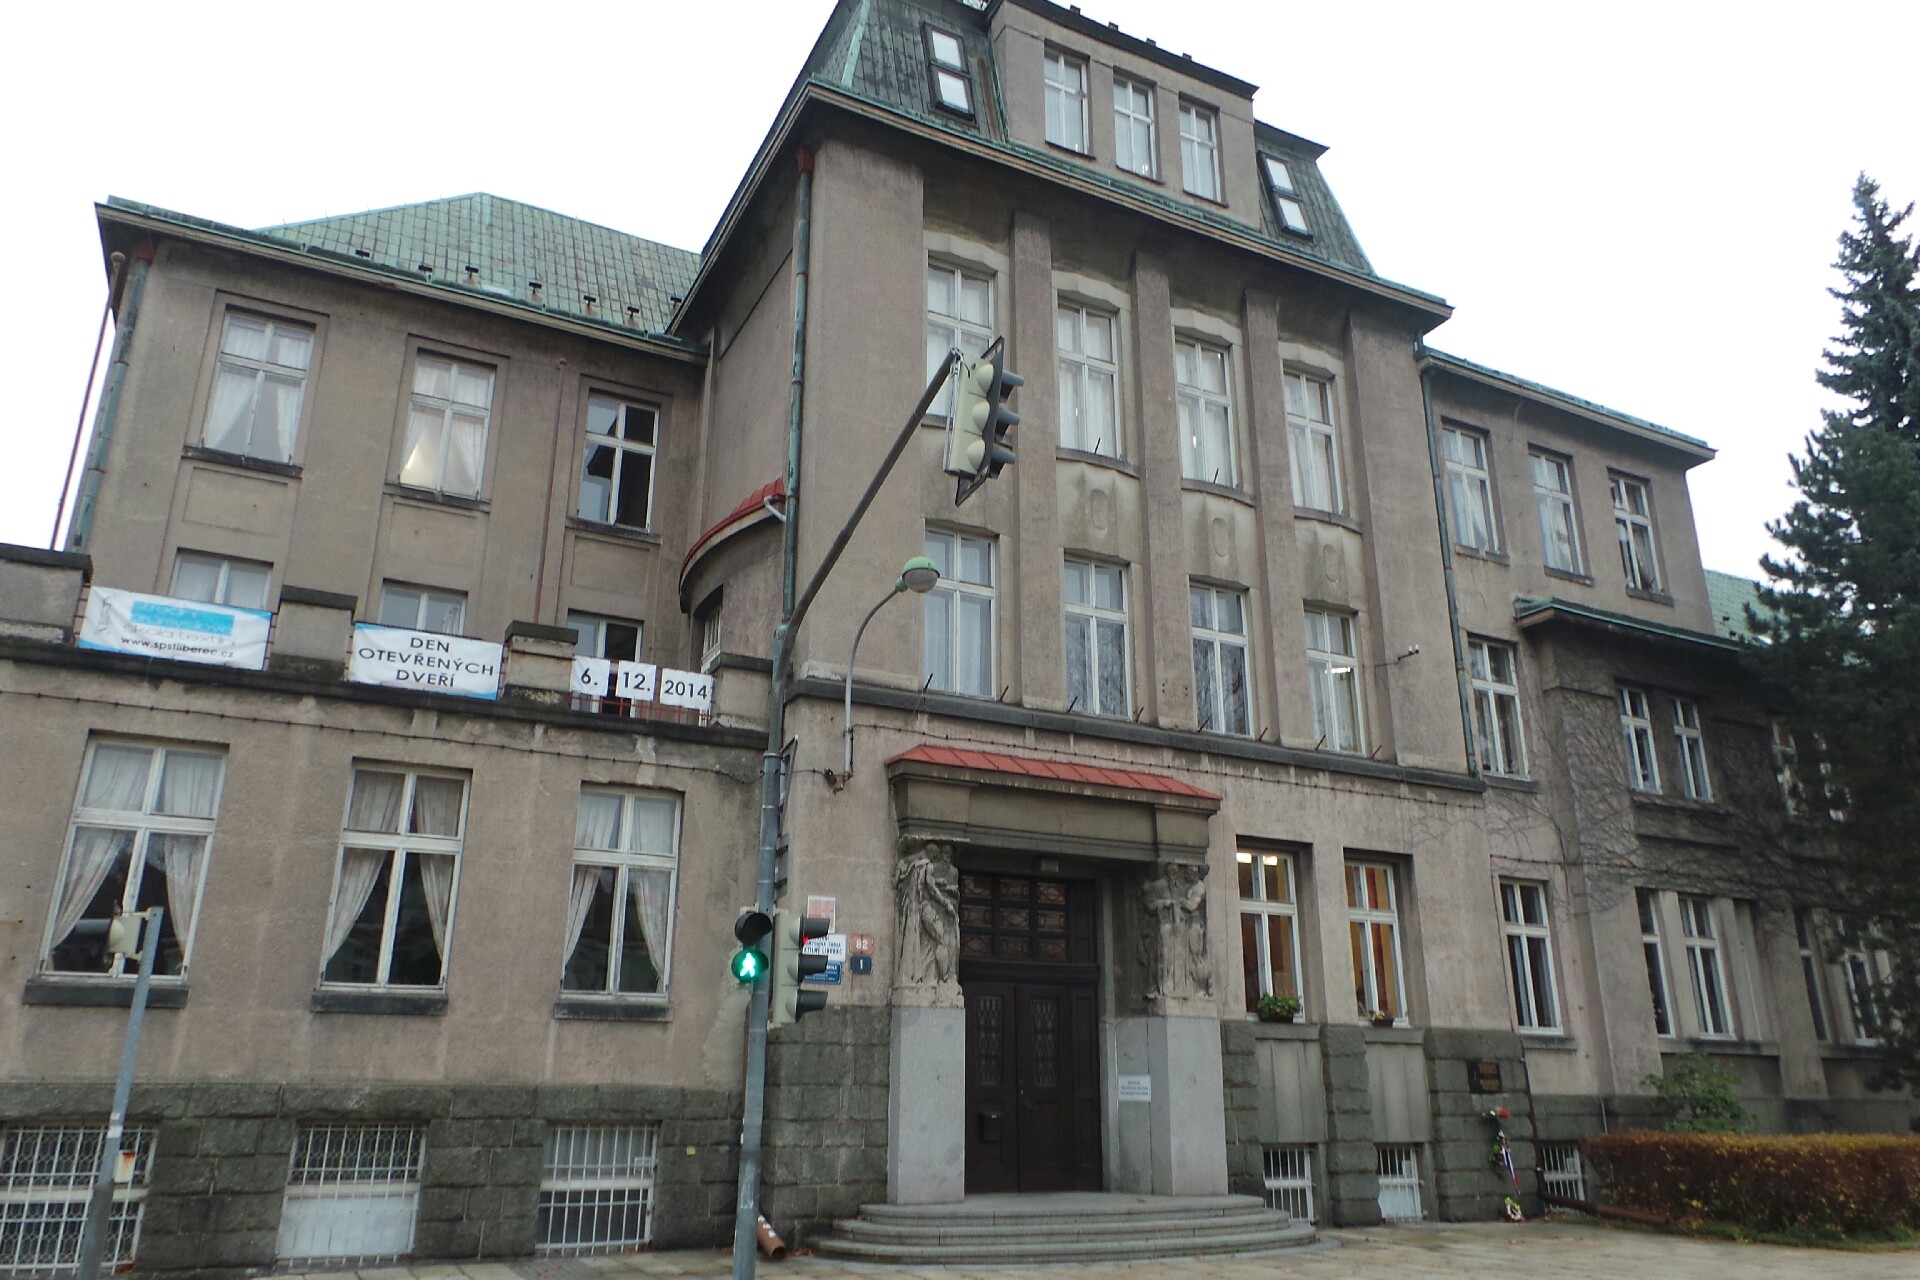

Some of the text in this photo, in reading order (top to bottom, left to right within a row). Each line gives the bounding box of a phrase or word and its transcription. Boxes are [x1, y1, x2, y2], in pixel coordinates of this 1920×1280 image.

[121, 636, 234, 658] www.spstliberec.cz
[410, 637, 450, 653] DEN
[358, 648, 494, 675] OTEVŘENÝCH
[396, 669, 456, 687] DVEŘÍ
[580, 668, 707, 700] 6. 12. 2014
[856, 939, 868, 951] 82
